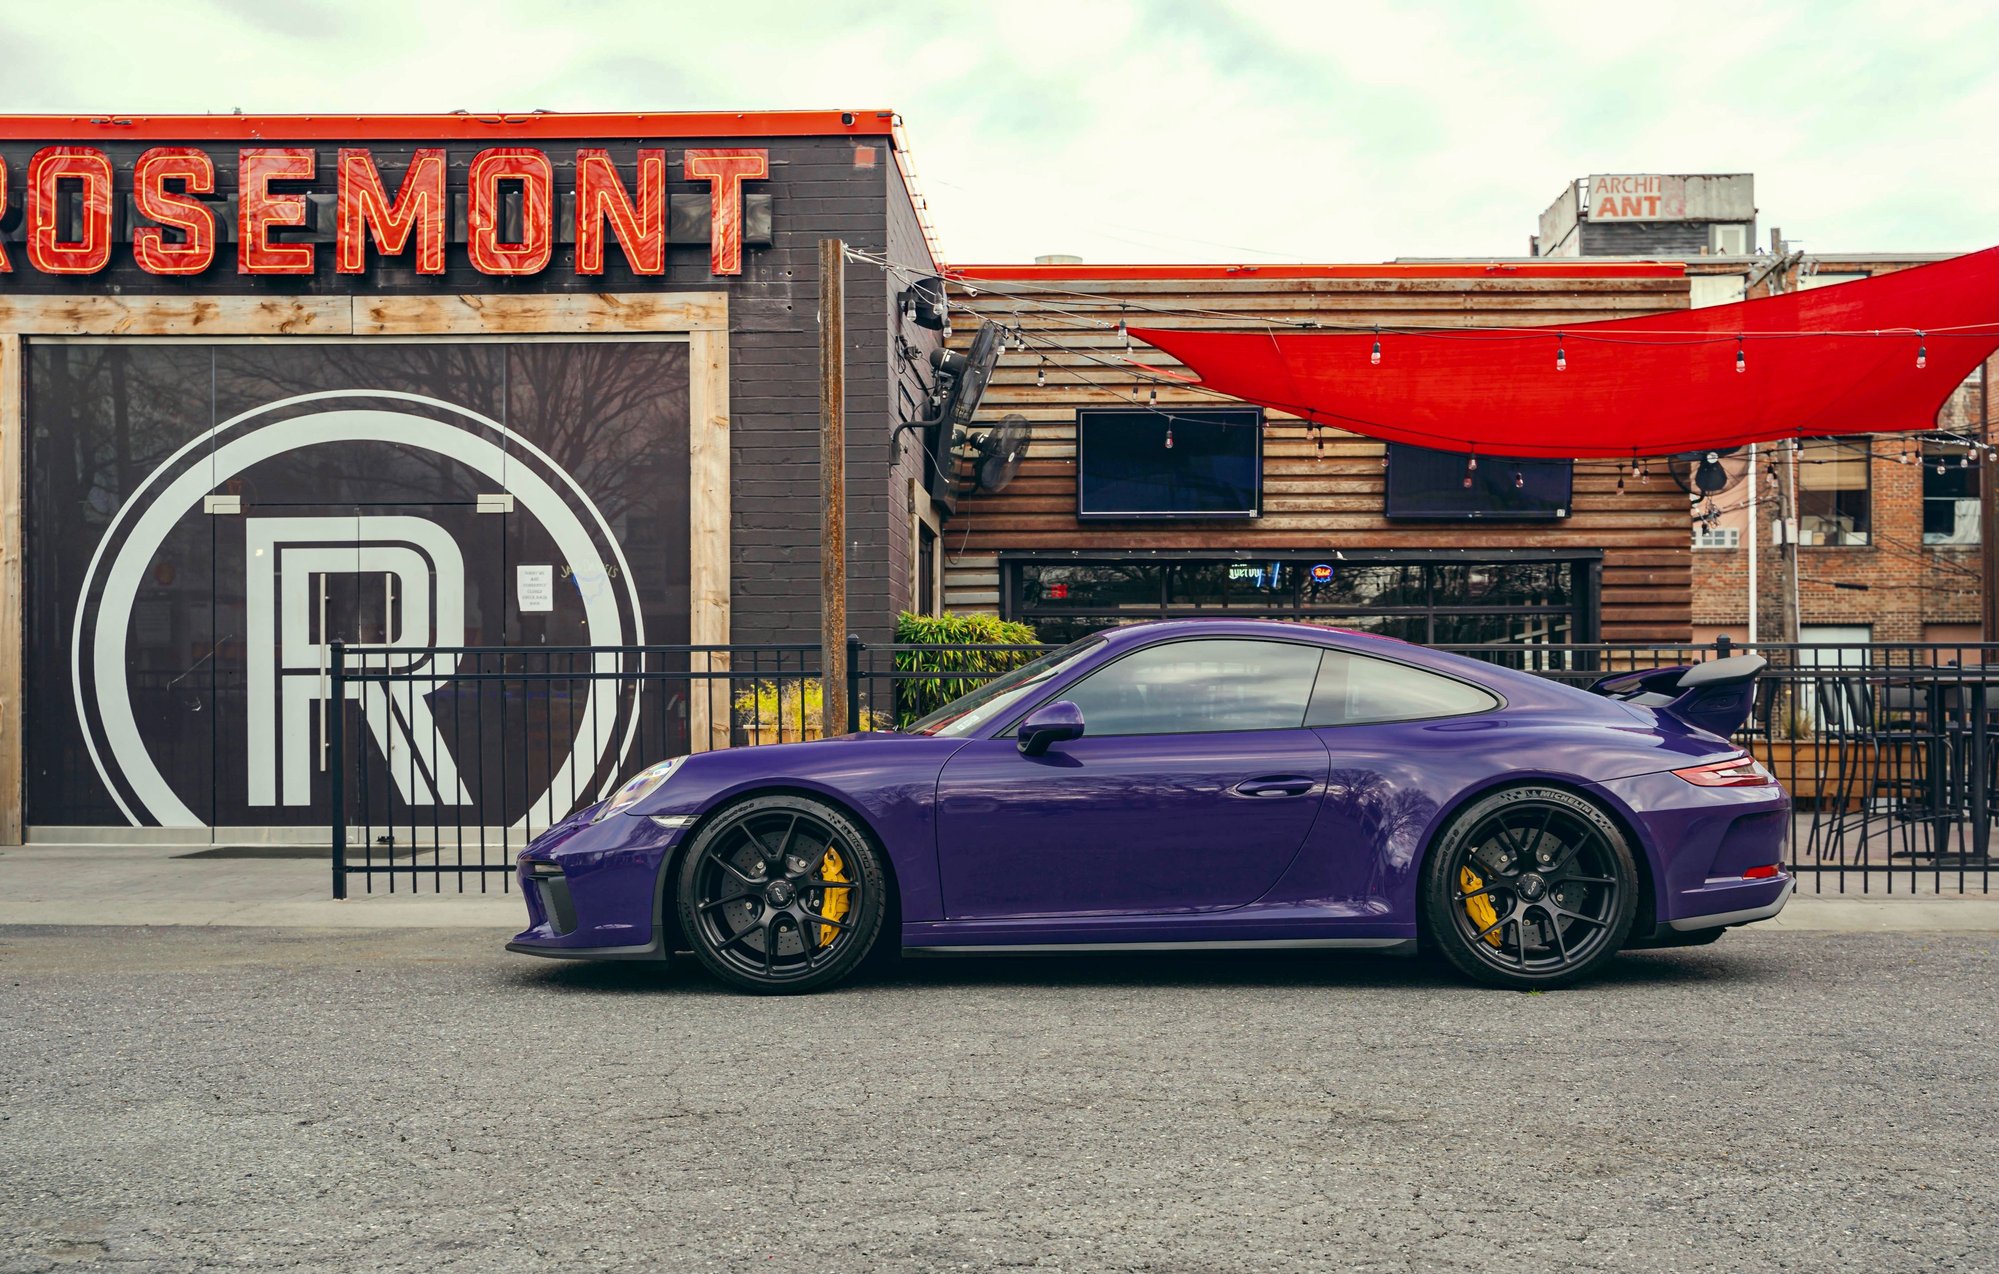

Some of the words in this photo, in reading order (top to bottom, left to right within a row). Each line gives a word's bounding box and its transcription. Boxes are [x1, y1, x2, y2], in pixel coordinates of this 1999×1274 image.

[0, 147, 769, 276] OSEMONT
[246, 516, 474, 807] R
[1539, 790, 1593, 814] MICHELIN
[848, 834, 871, 869] MICHELIN
